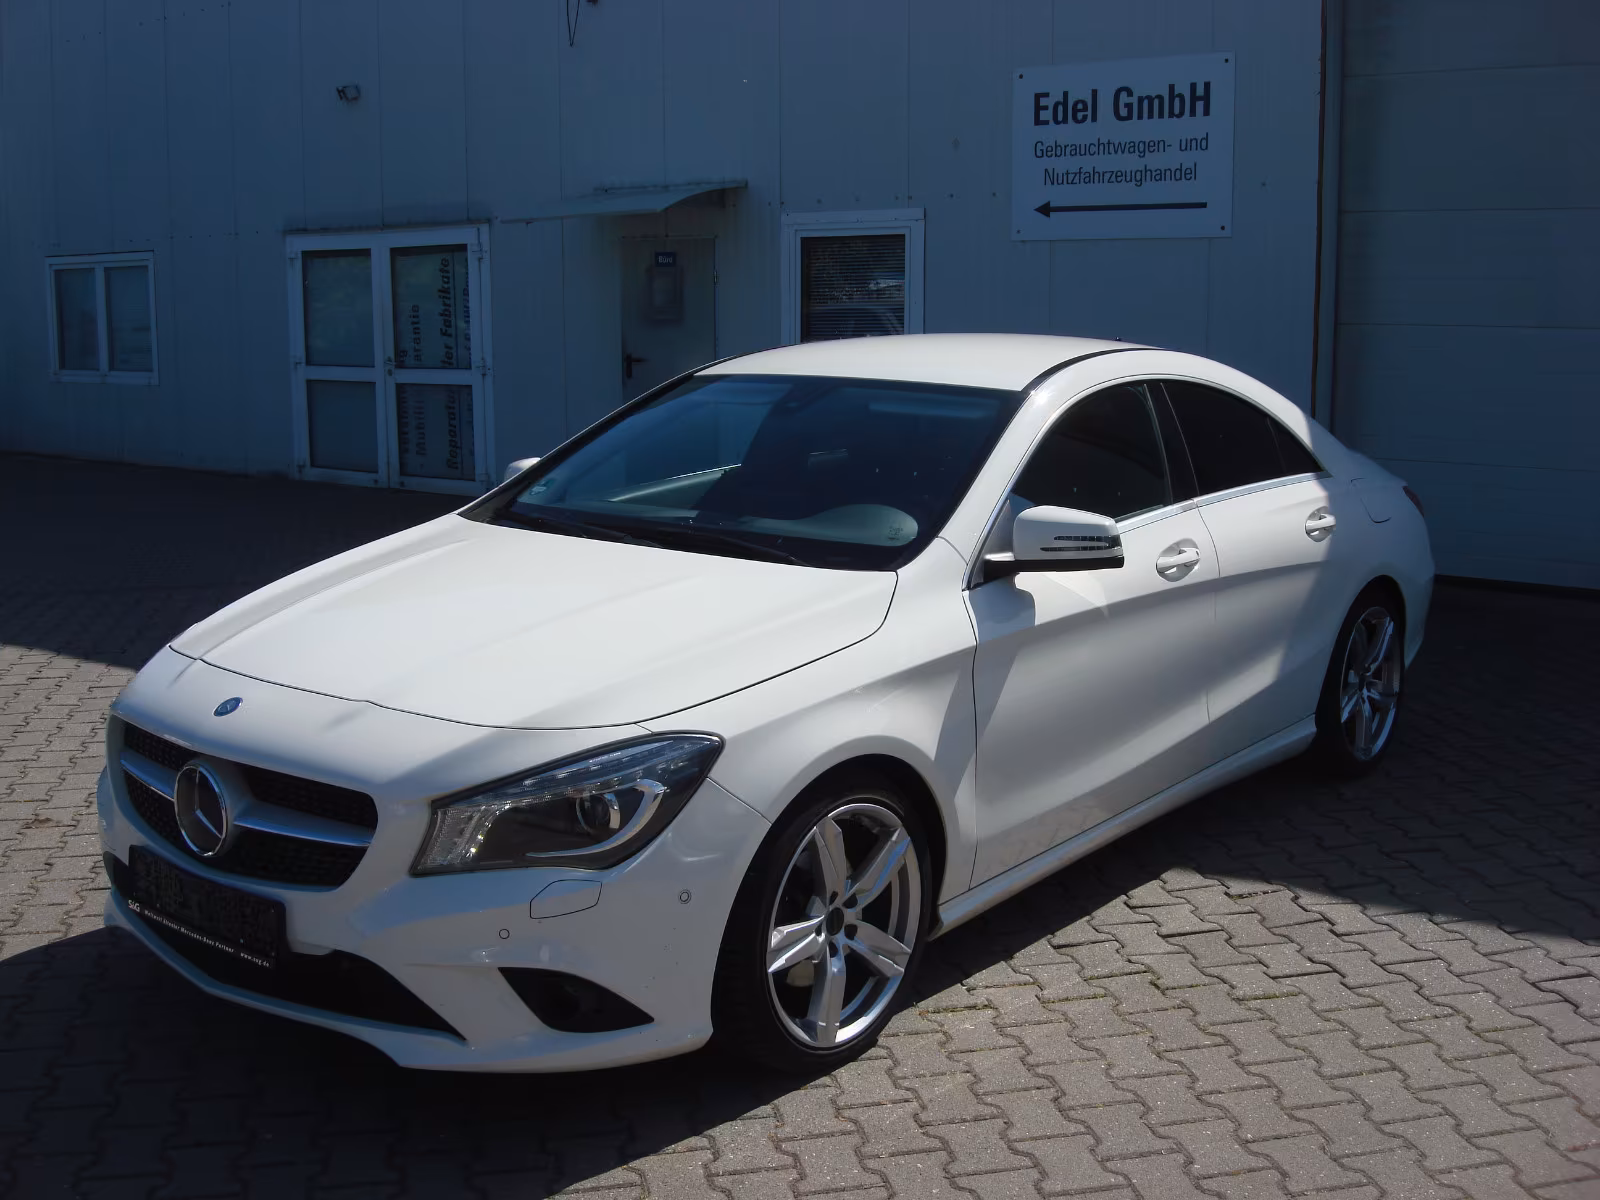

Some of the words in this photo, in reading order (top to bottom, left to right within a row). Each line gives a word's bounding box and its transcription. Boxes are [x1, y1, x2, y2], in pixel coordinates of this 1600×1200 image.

[1033, 88, 1098, 126] Edel
[1112, 81, 1211, 122] GmbH
[1034, 137, 1172, 159] Gebrauchtwagen-
[1179, 132, 1209, 152] und
[1044, 161, 1197, 187] Nutzfahrzeughandel
[437, 257, 453, 338] Fabrikate
[409, 304, 422, 363] arantie
